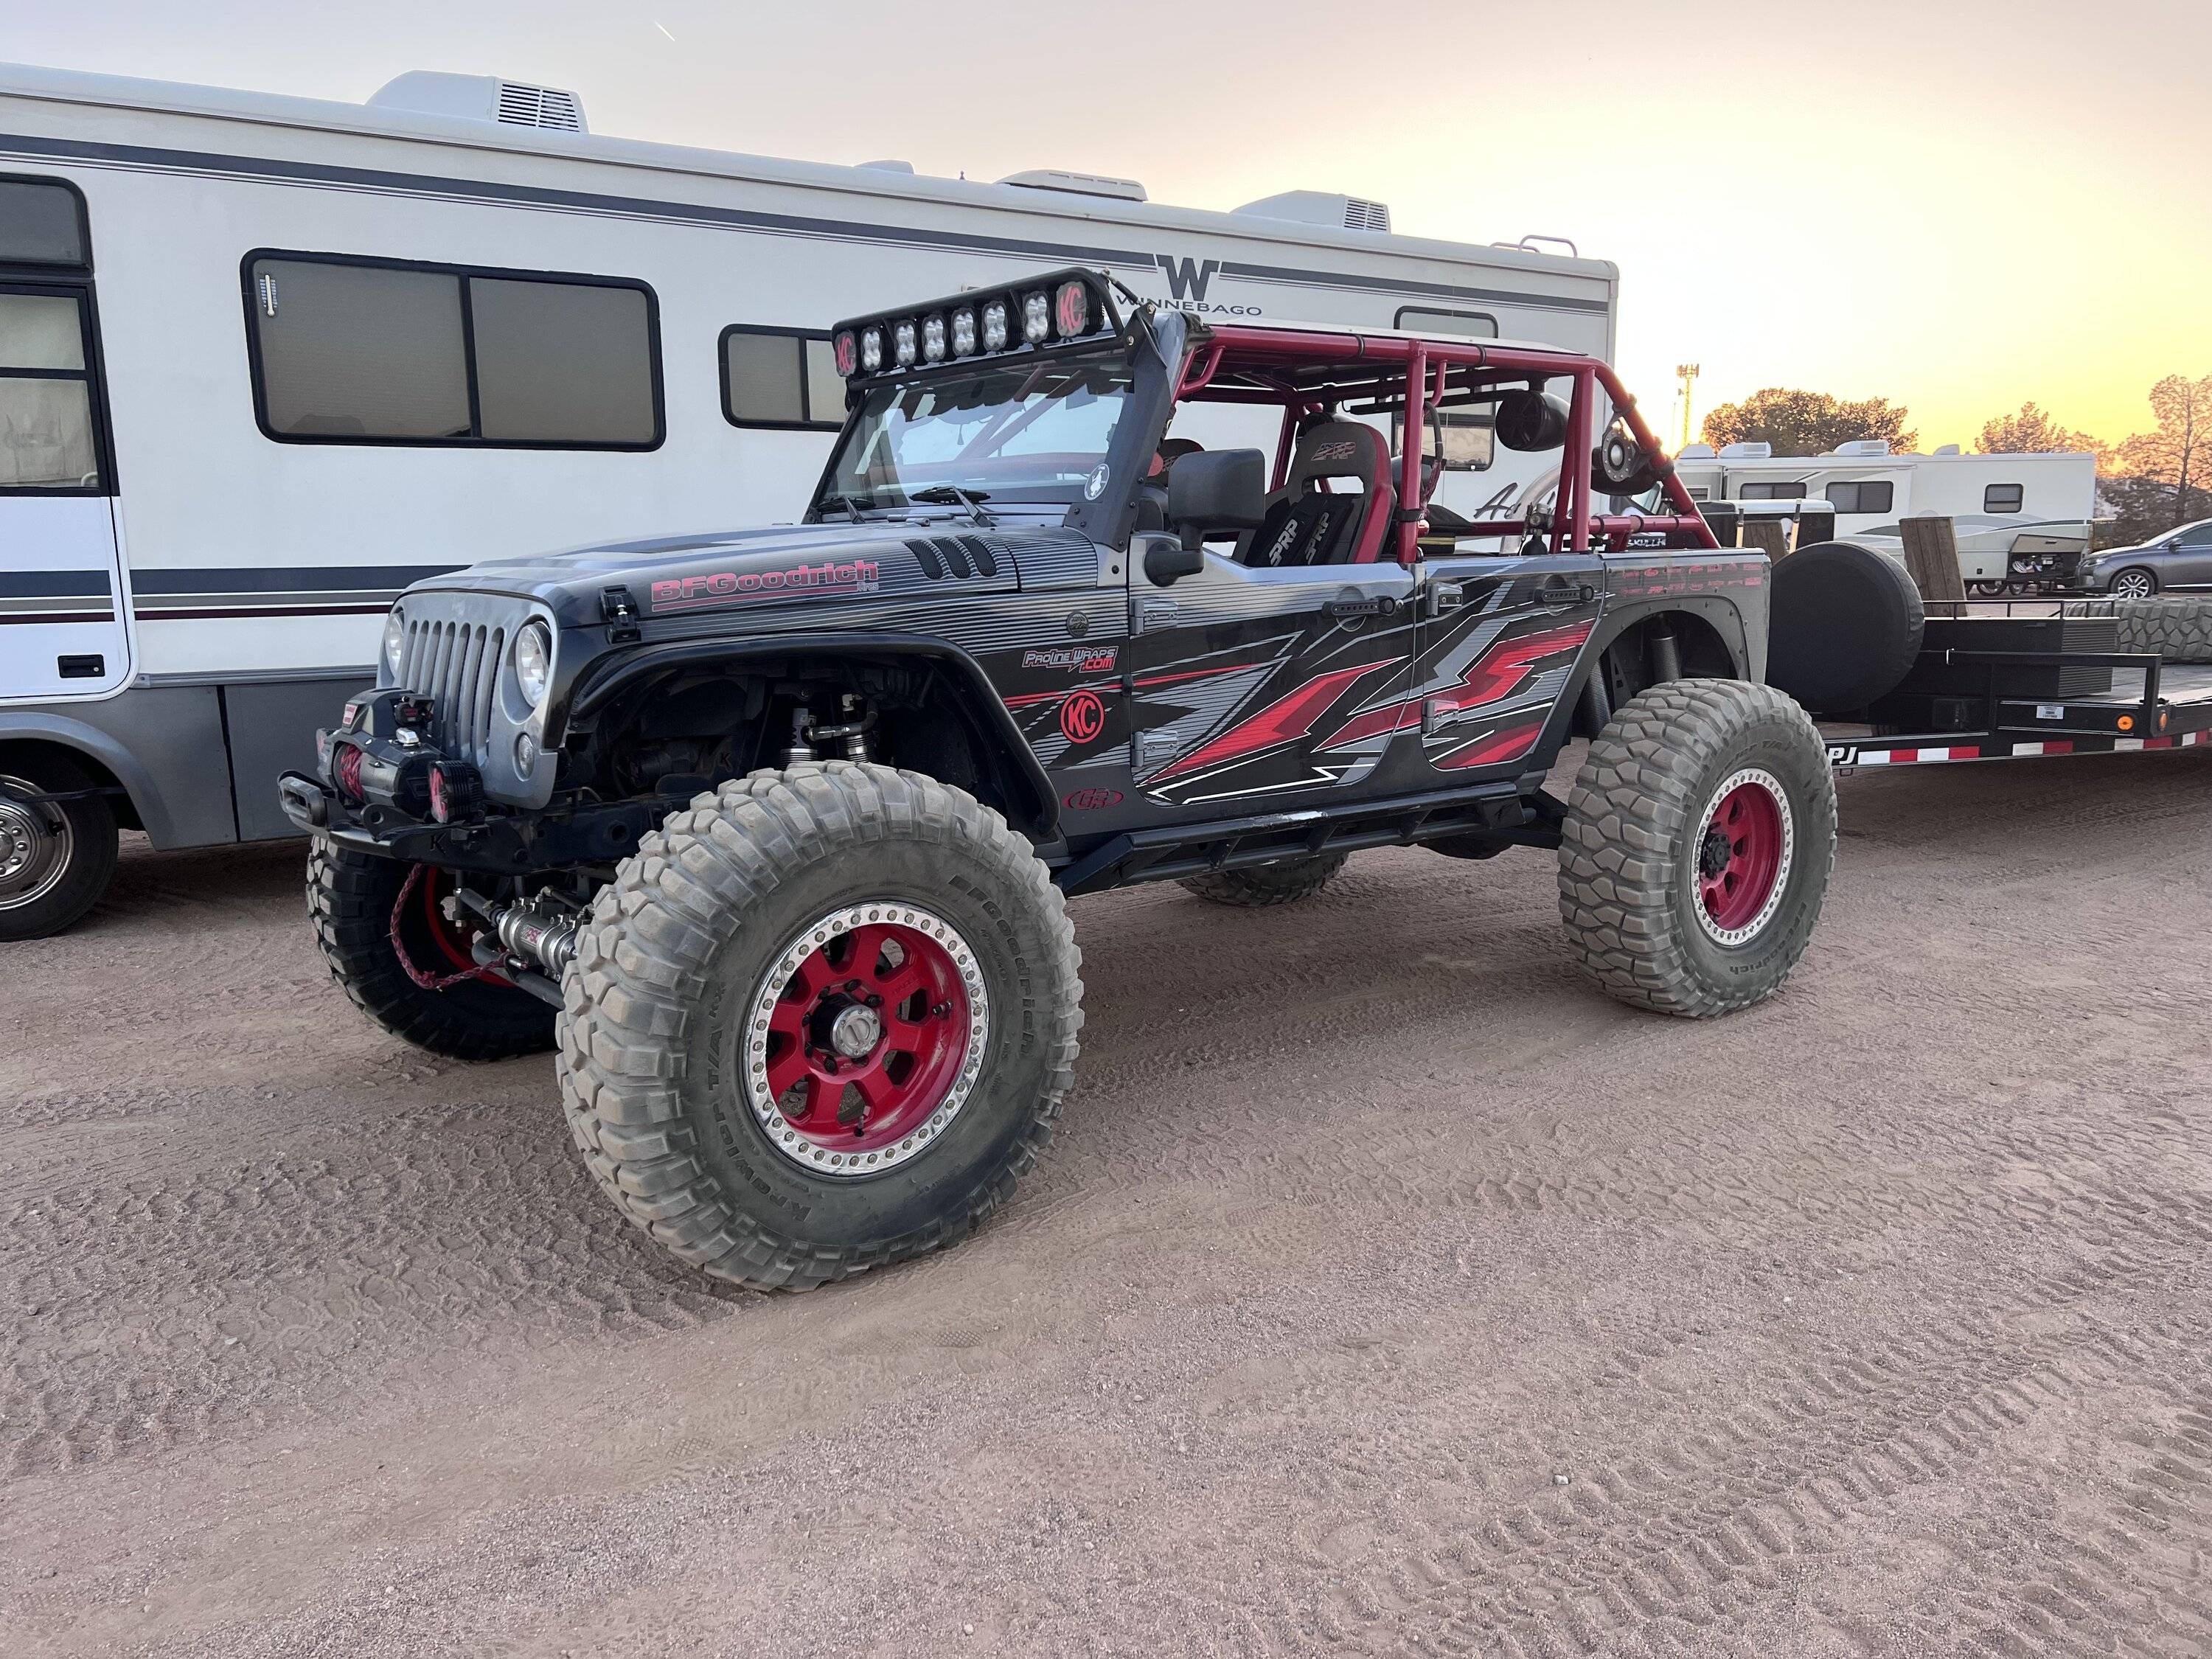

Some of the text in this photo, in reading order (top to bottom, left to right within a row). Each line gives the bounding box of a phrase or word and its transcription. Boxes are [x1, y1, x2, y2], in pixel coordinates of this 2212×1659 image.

[1155, 254, 1220, 302] W
[651, 560, 879, 602] BFGoodrich
[1068, 698, 1096, 737] KC
[1827, 746, 1858, 765] PJ
